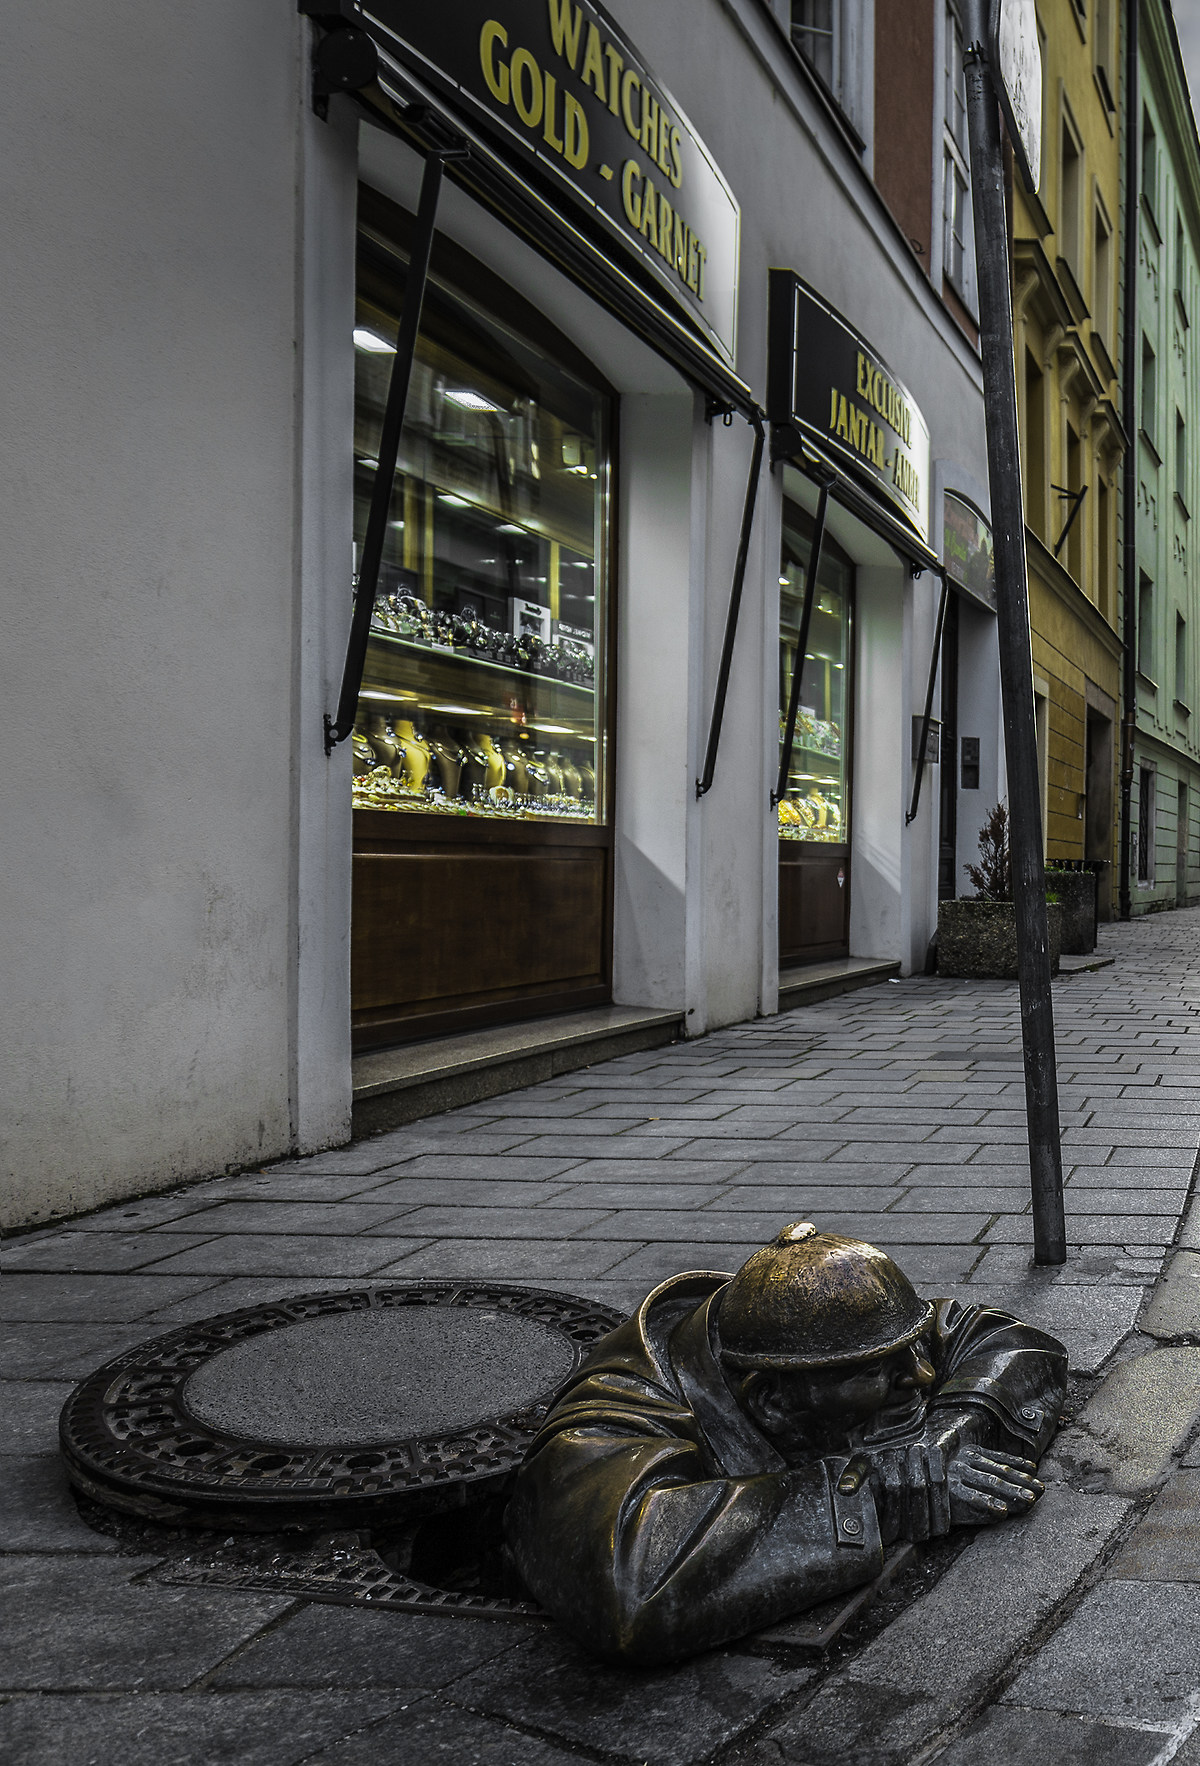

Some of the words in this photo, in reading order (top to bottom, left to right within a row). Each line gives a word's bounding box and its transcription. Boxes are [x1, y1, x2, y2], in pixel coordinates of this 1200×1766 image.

[479, 19, 590, 170] GOLD
[621, 158, 707, 302] GARNET
[549, 0, 682, 189] WATCHES
[829, 386, 885, 472] JANTAR
